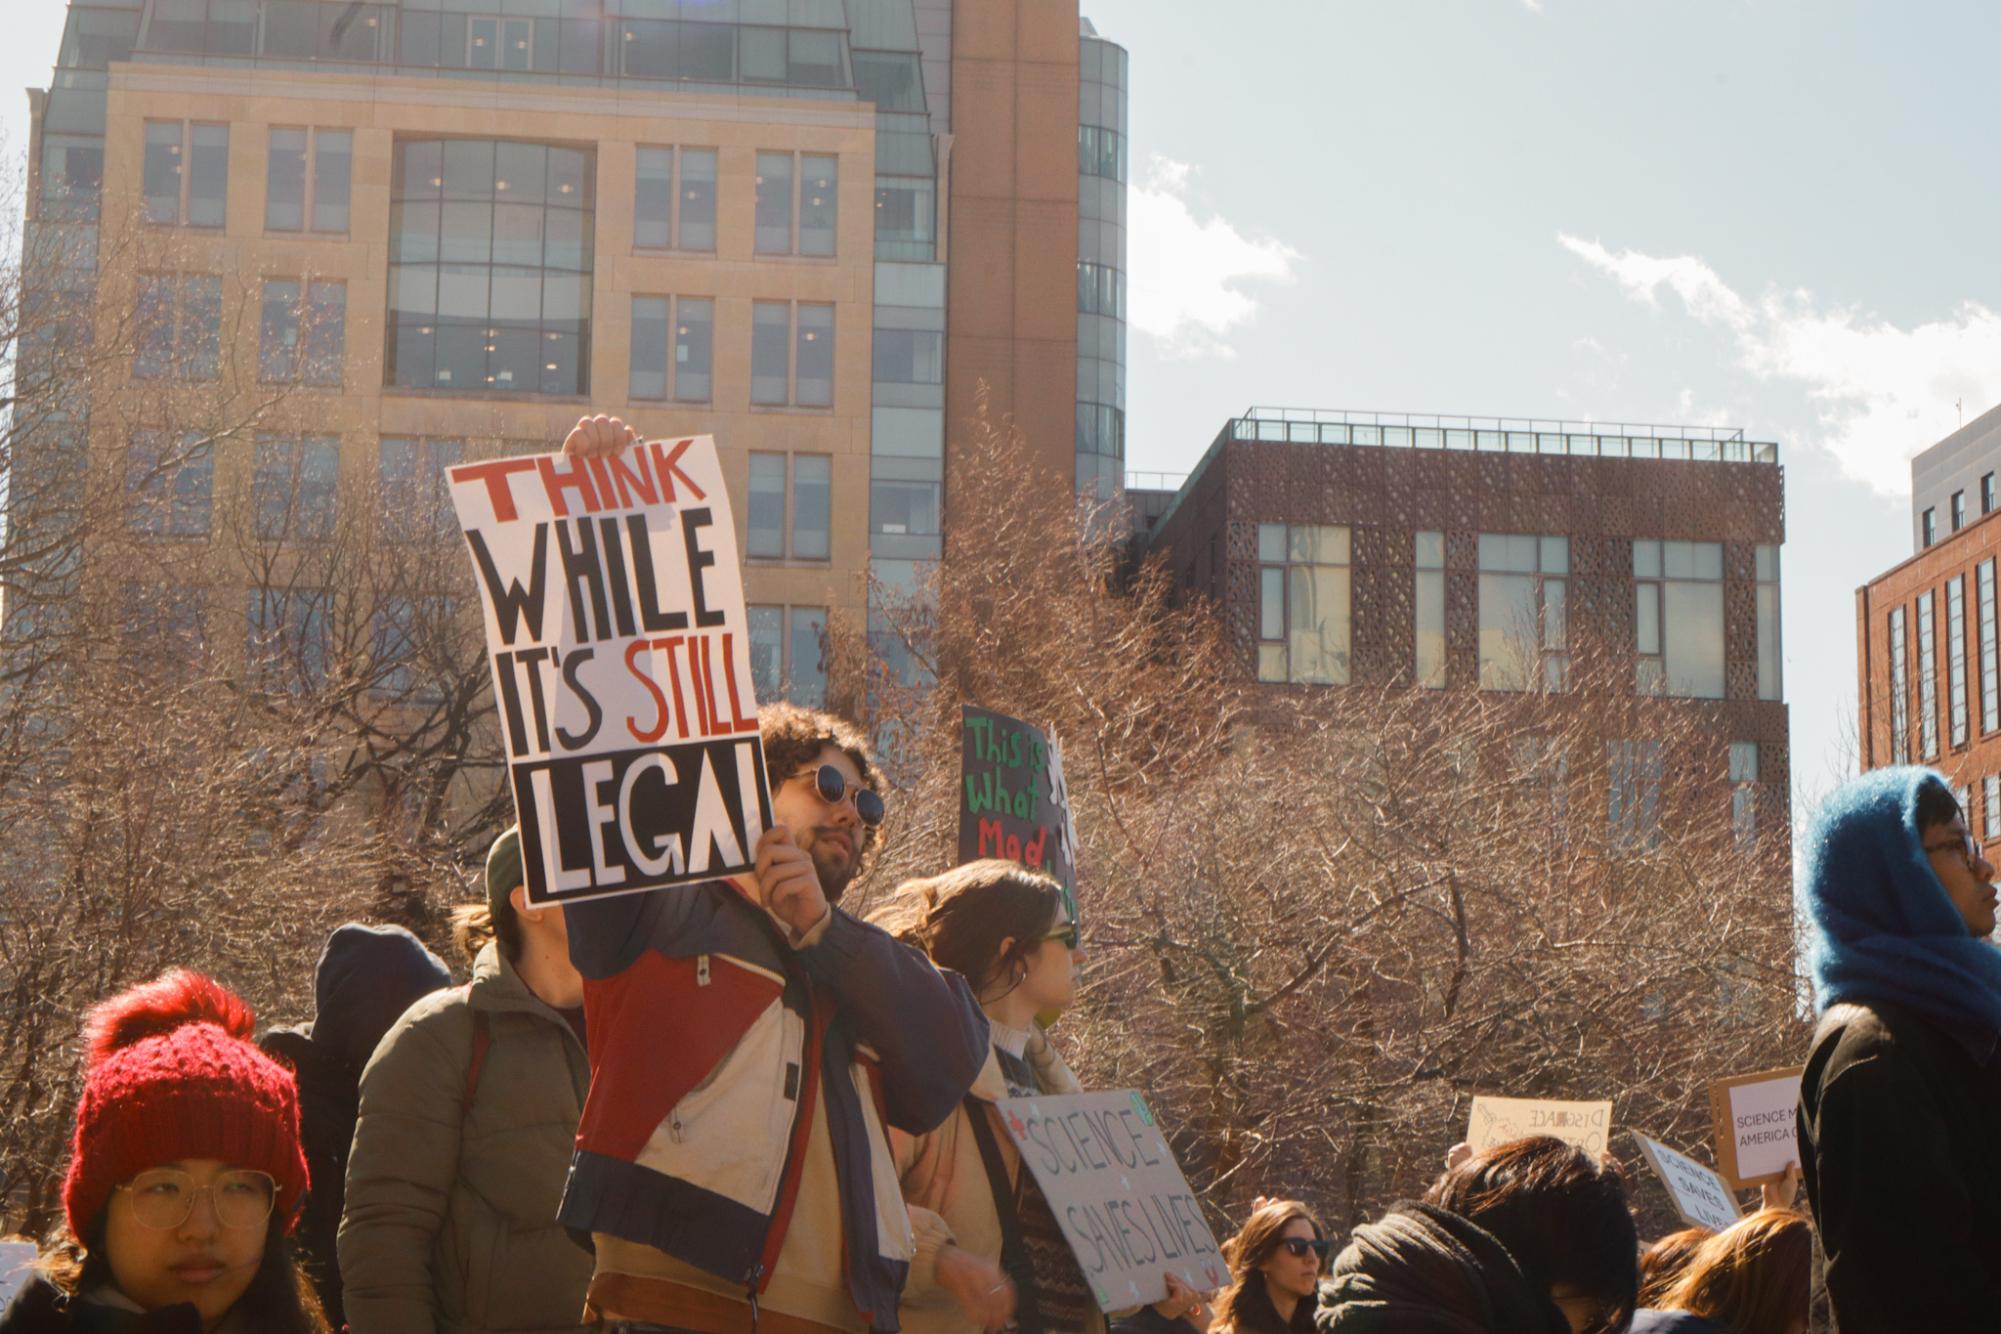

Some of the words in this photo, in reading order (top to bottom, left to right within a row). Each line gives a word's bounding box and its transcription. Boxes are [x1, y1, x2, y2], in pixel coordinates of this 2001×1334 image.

[451, 439, 708, 523] THINK
[464, 506, 726, 646] WHILE
[495, 645, 603, 758] IT'S
[624, 632, 760, 744] STILL
[964, 716, 1023, 769] This
[1027, 730, 1045, 773] is
[964, 765, 1041, 822] What
[977, 816, 1048, 868] Mad
[1025, 1108, 1160, 1176] SCIENCE
[1736, 1109, 1787, 1129] SCIENCE
[1739, 1127, 1790, 1147] AMERICA
[1656, 1149, 1721, 1191] SCIENCE
[1678, 1176, 1725, 1212] SAVES
[1066, 1199, 1157, 1274] SAVES
[1137, 1194, 1217, 1260] LIVES
